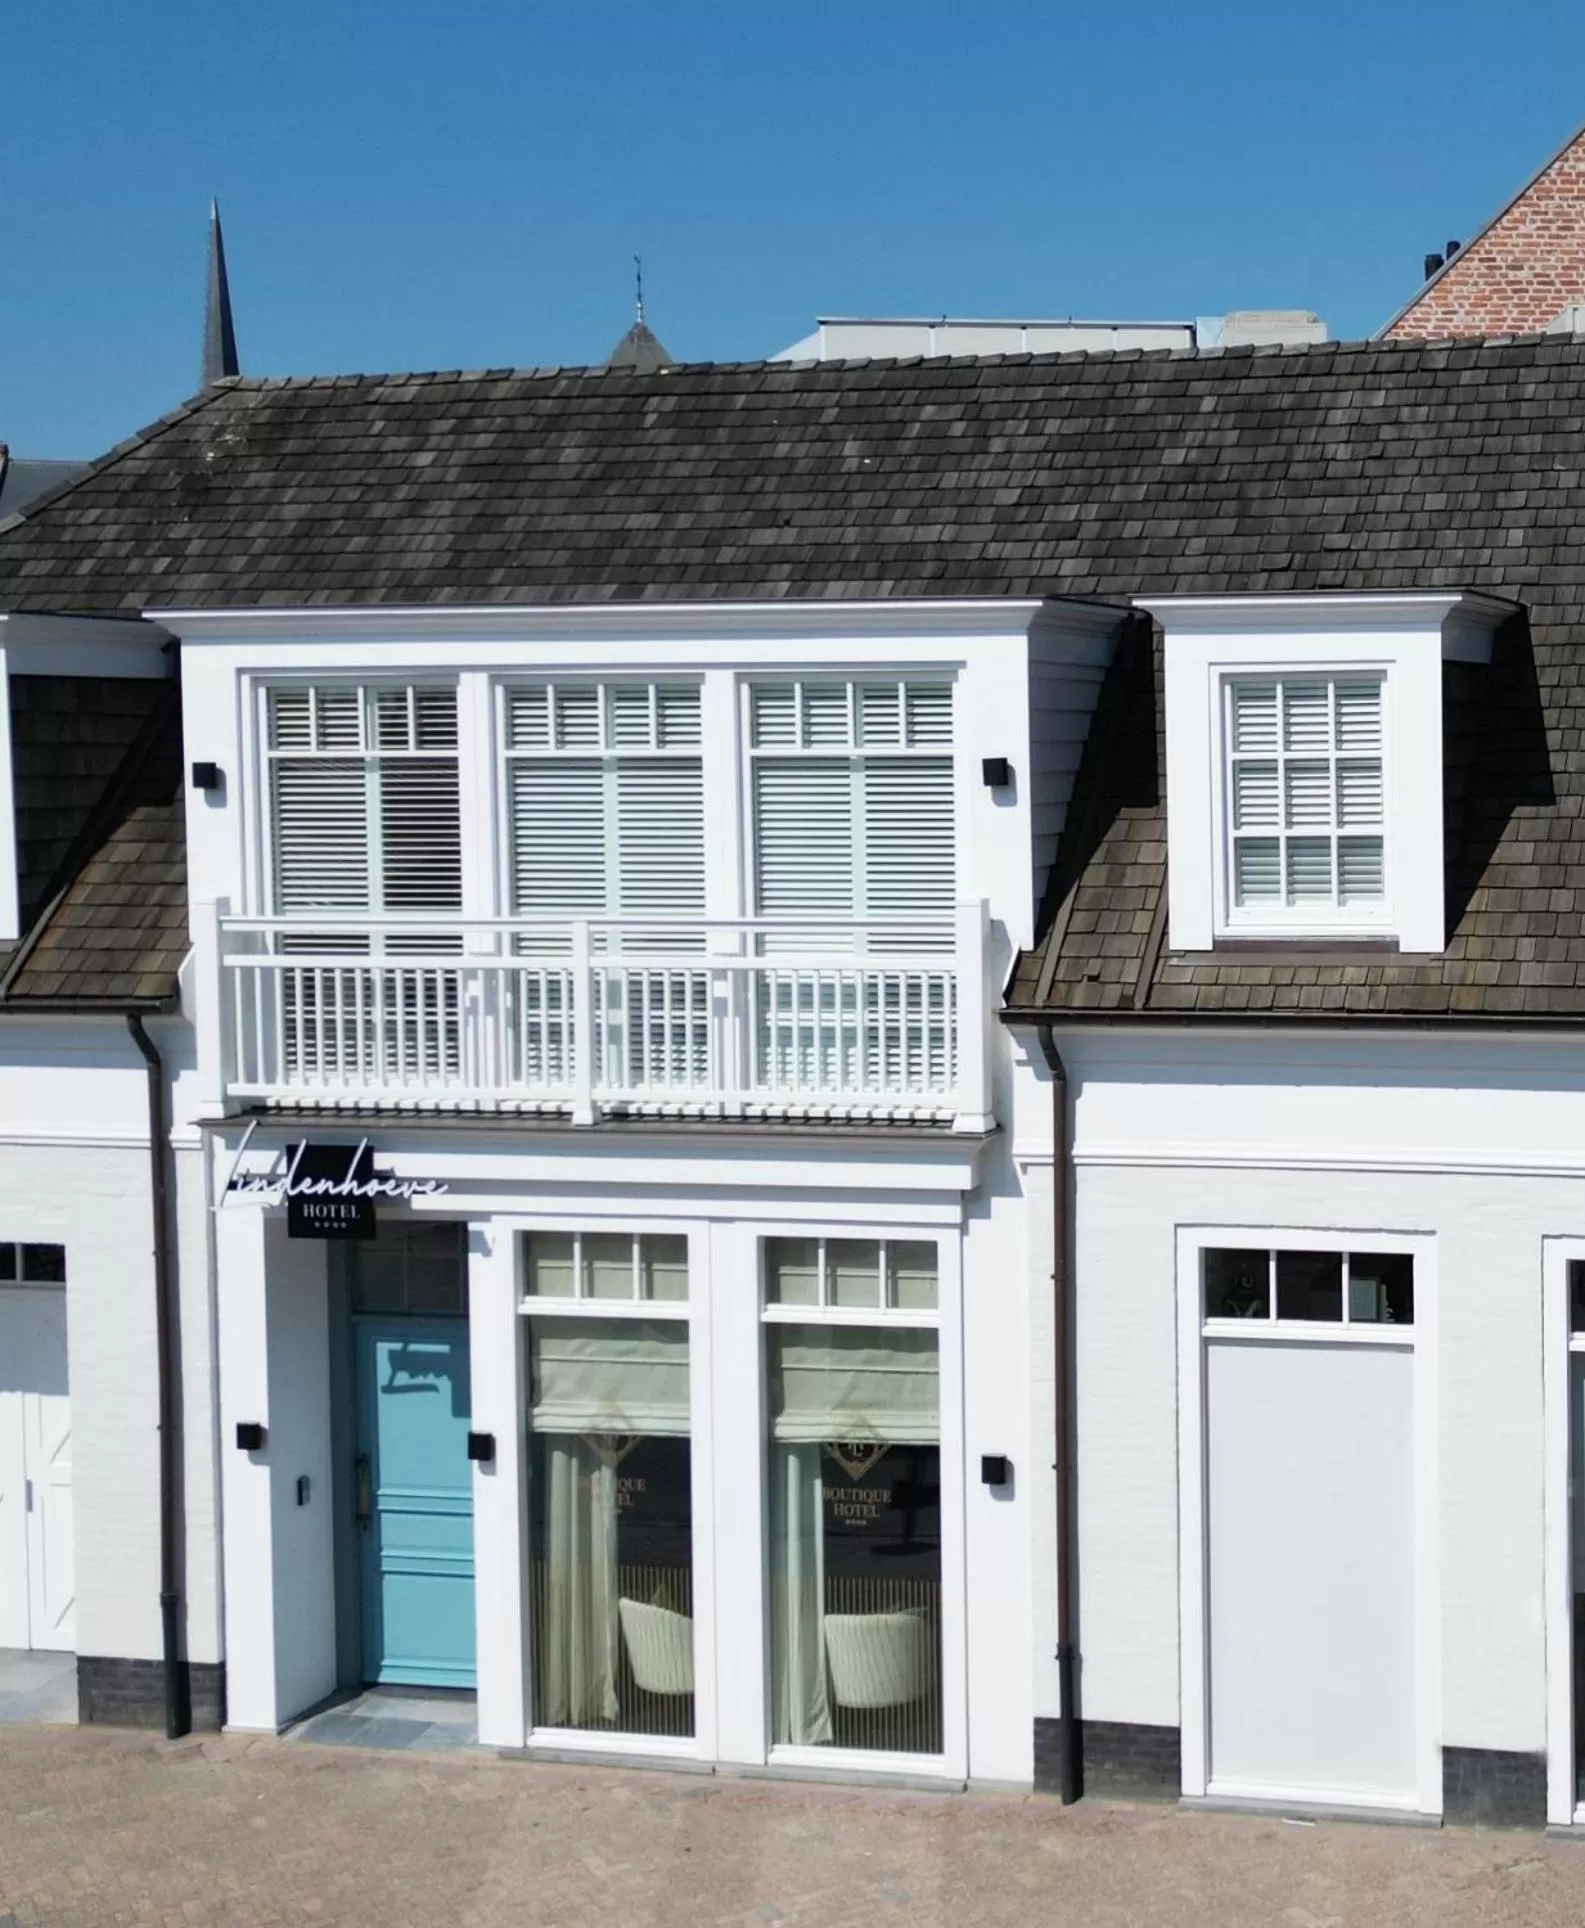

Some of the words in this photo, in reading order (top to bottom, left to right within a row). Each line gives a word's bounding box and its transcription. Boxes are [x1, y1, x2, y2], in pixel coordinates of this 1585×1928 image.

[210, 1119, 449, 1212] Lindenhoeve
[302, 1203, 361, 1219] HOTEL
[821, 1487, 892, 1503] BOUTIQUE
[833, 1503, 881, 1518] HOTEL
